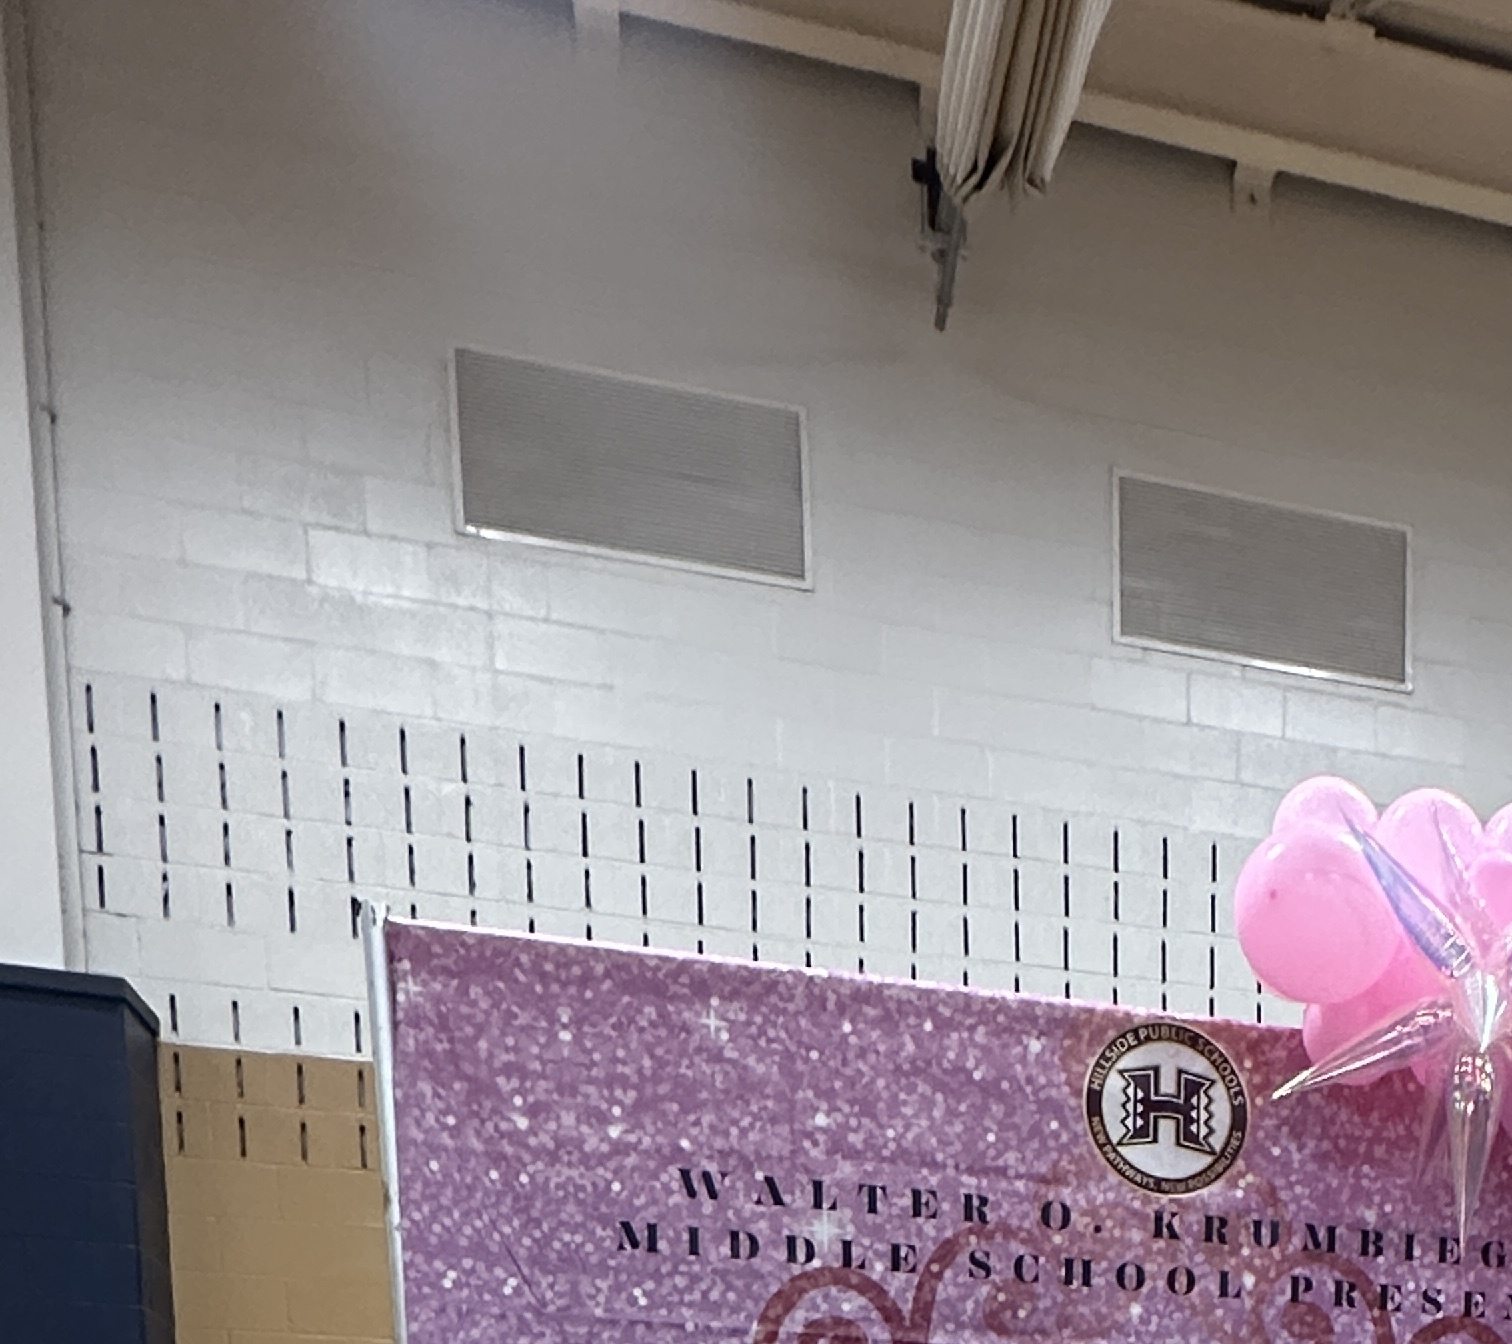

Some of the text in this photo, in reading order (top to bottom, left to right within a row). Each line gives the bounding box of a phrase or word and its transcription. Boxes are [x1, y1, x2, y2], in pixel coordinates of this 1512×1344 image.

[1090, 1025, 1243, 1106] HILLSIDE PUBLIC SCHOOLS
[1117, 1065, 1218, 1156] H
[679, 1168, 990, 1225] WALTER
[1041, 1199, 1103, 1234] O.
[617, 1220, 918, 1274] MIDDLE
[968, 1249, 1242, 1300] SCHOOL
